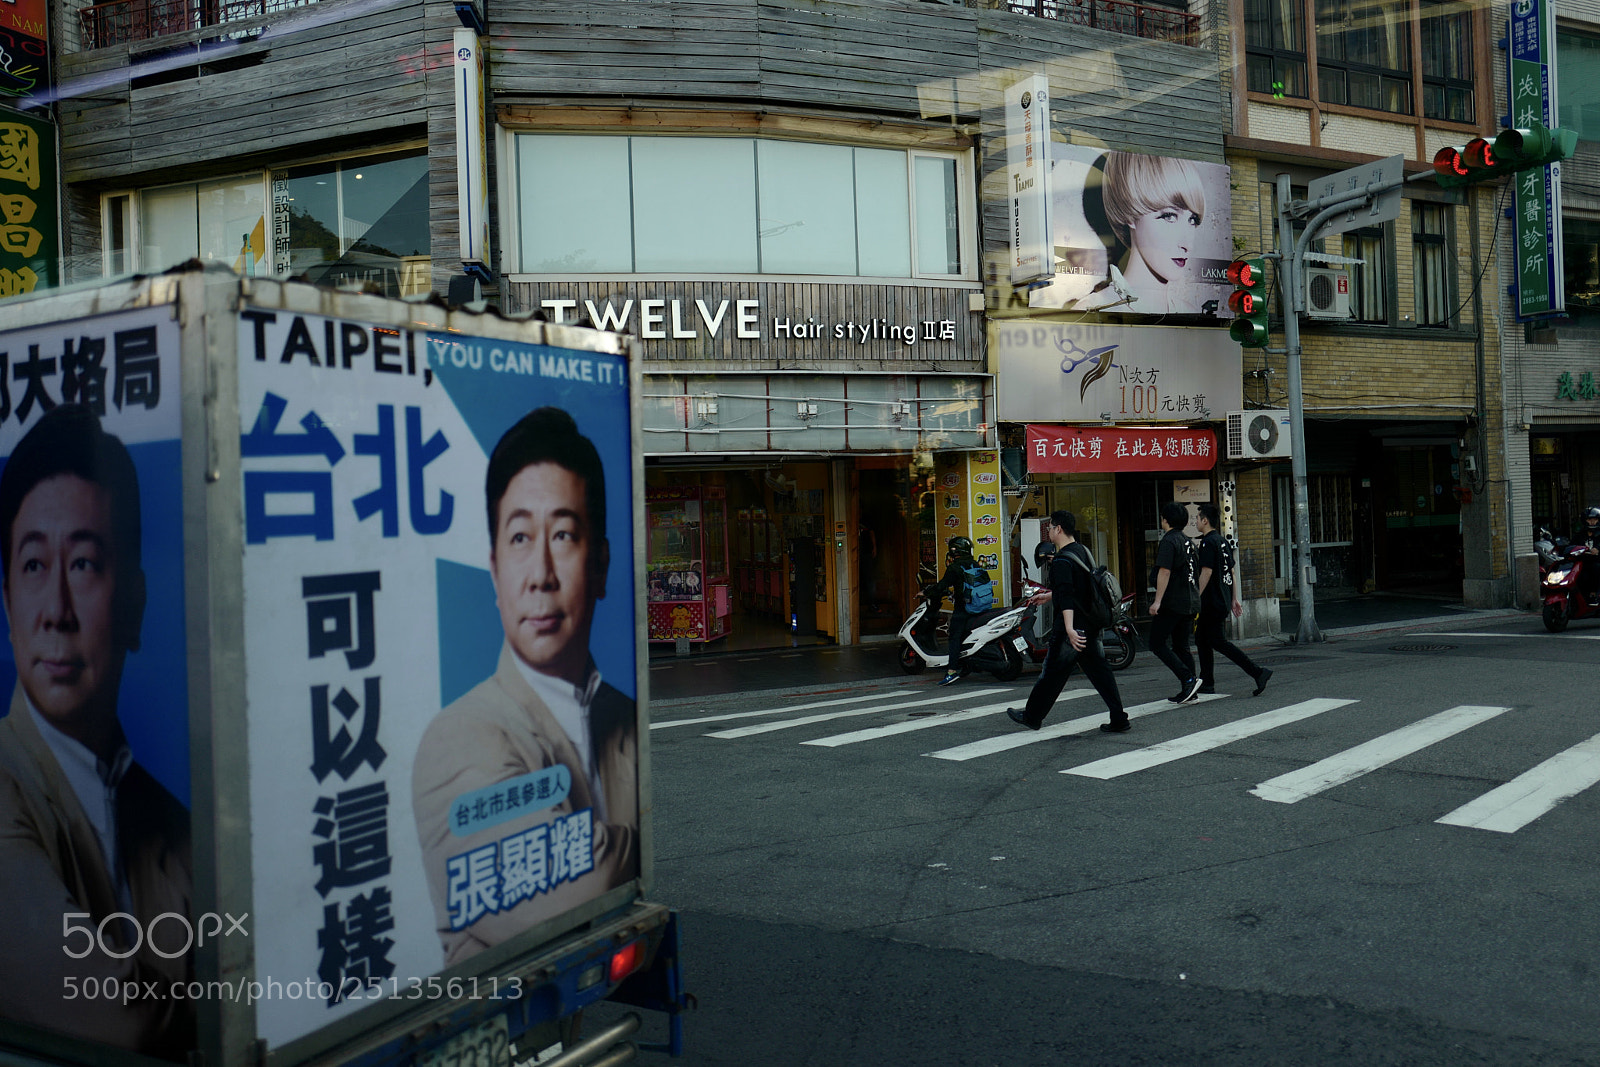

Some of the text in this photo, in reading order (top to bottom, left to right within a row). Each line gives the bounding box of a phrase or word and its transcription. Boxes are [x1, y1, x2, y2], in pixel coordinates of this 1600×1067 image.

[12, 13, 43, 36] NAM
[541, 299, 760, 339] TWELVE
[774, 317, 825, 340] Hair
[834, 318, 917, 345] styling
[240, 311, 433, 387] TAIPEI,
[434, 342, 482, 370] YOU
[489, 348, 533, 377] CAN
[539, 354, 593, 382] MAKE
[1119, 364, 1160, 385] N次方
[240, 391, 454, 545] 台北
[1033, 436, 1211, 459] 百元快剪 在此為您服務
[652, 627, 701, 640] KING
[301, 570, 397, 1008] 可以這樣
[455, 773, 566, 827] 台北市長參選人
[446, 807, 594, 932] 張顯耀
